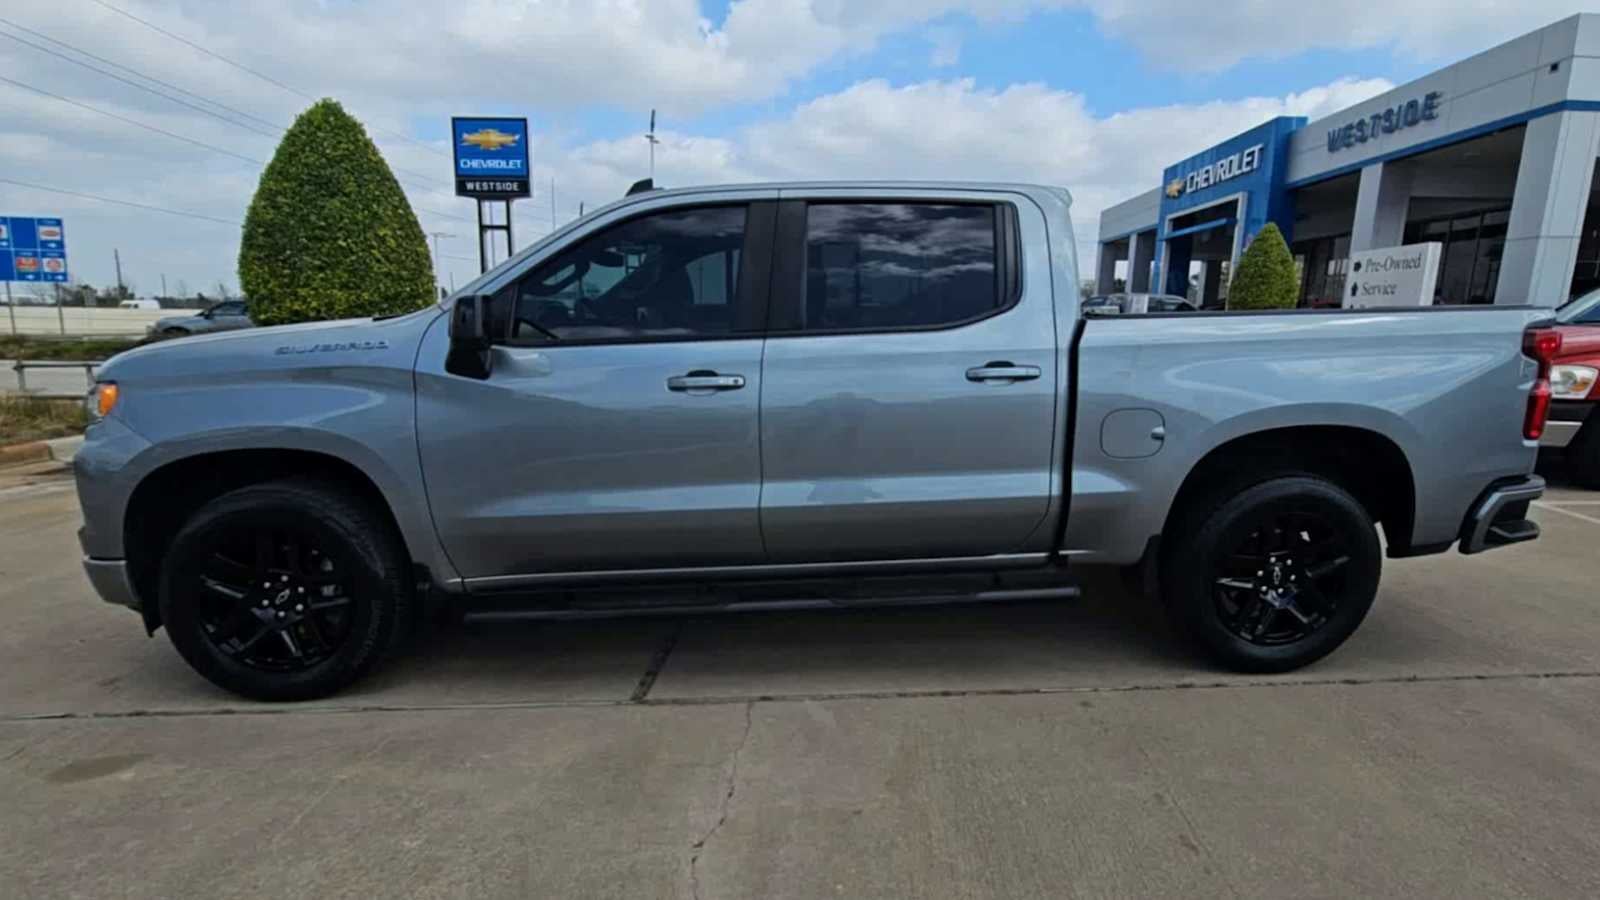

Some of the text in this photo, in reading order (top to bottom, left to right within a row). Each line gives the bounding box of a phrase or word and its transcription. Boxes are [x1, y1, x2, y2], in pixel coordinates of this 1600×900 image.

[1327, 91, 1440, 152] WESTSIDE
[460, 158, 522, 169] CHEVROLET
[1186, 143, 1264, 194] CHEVROLET
[465, 181, 520, 191] WESTSIDE
[1365, 252, 1422, 273] Pre-Owned
[1361, 281, 1397, 296] Service
